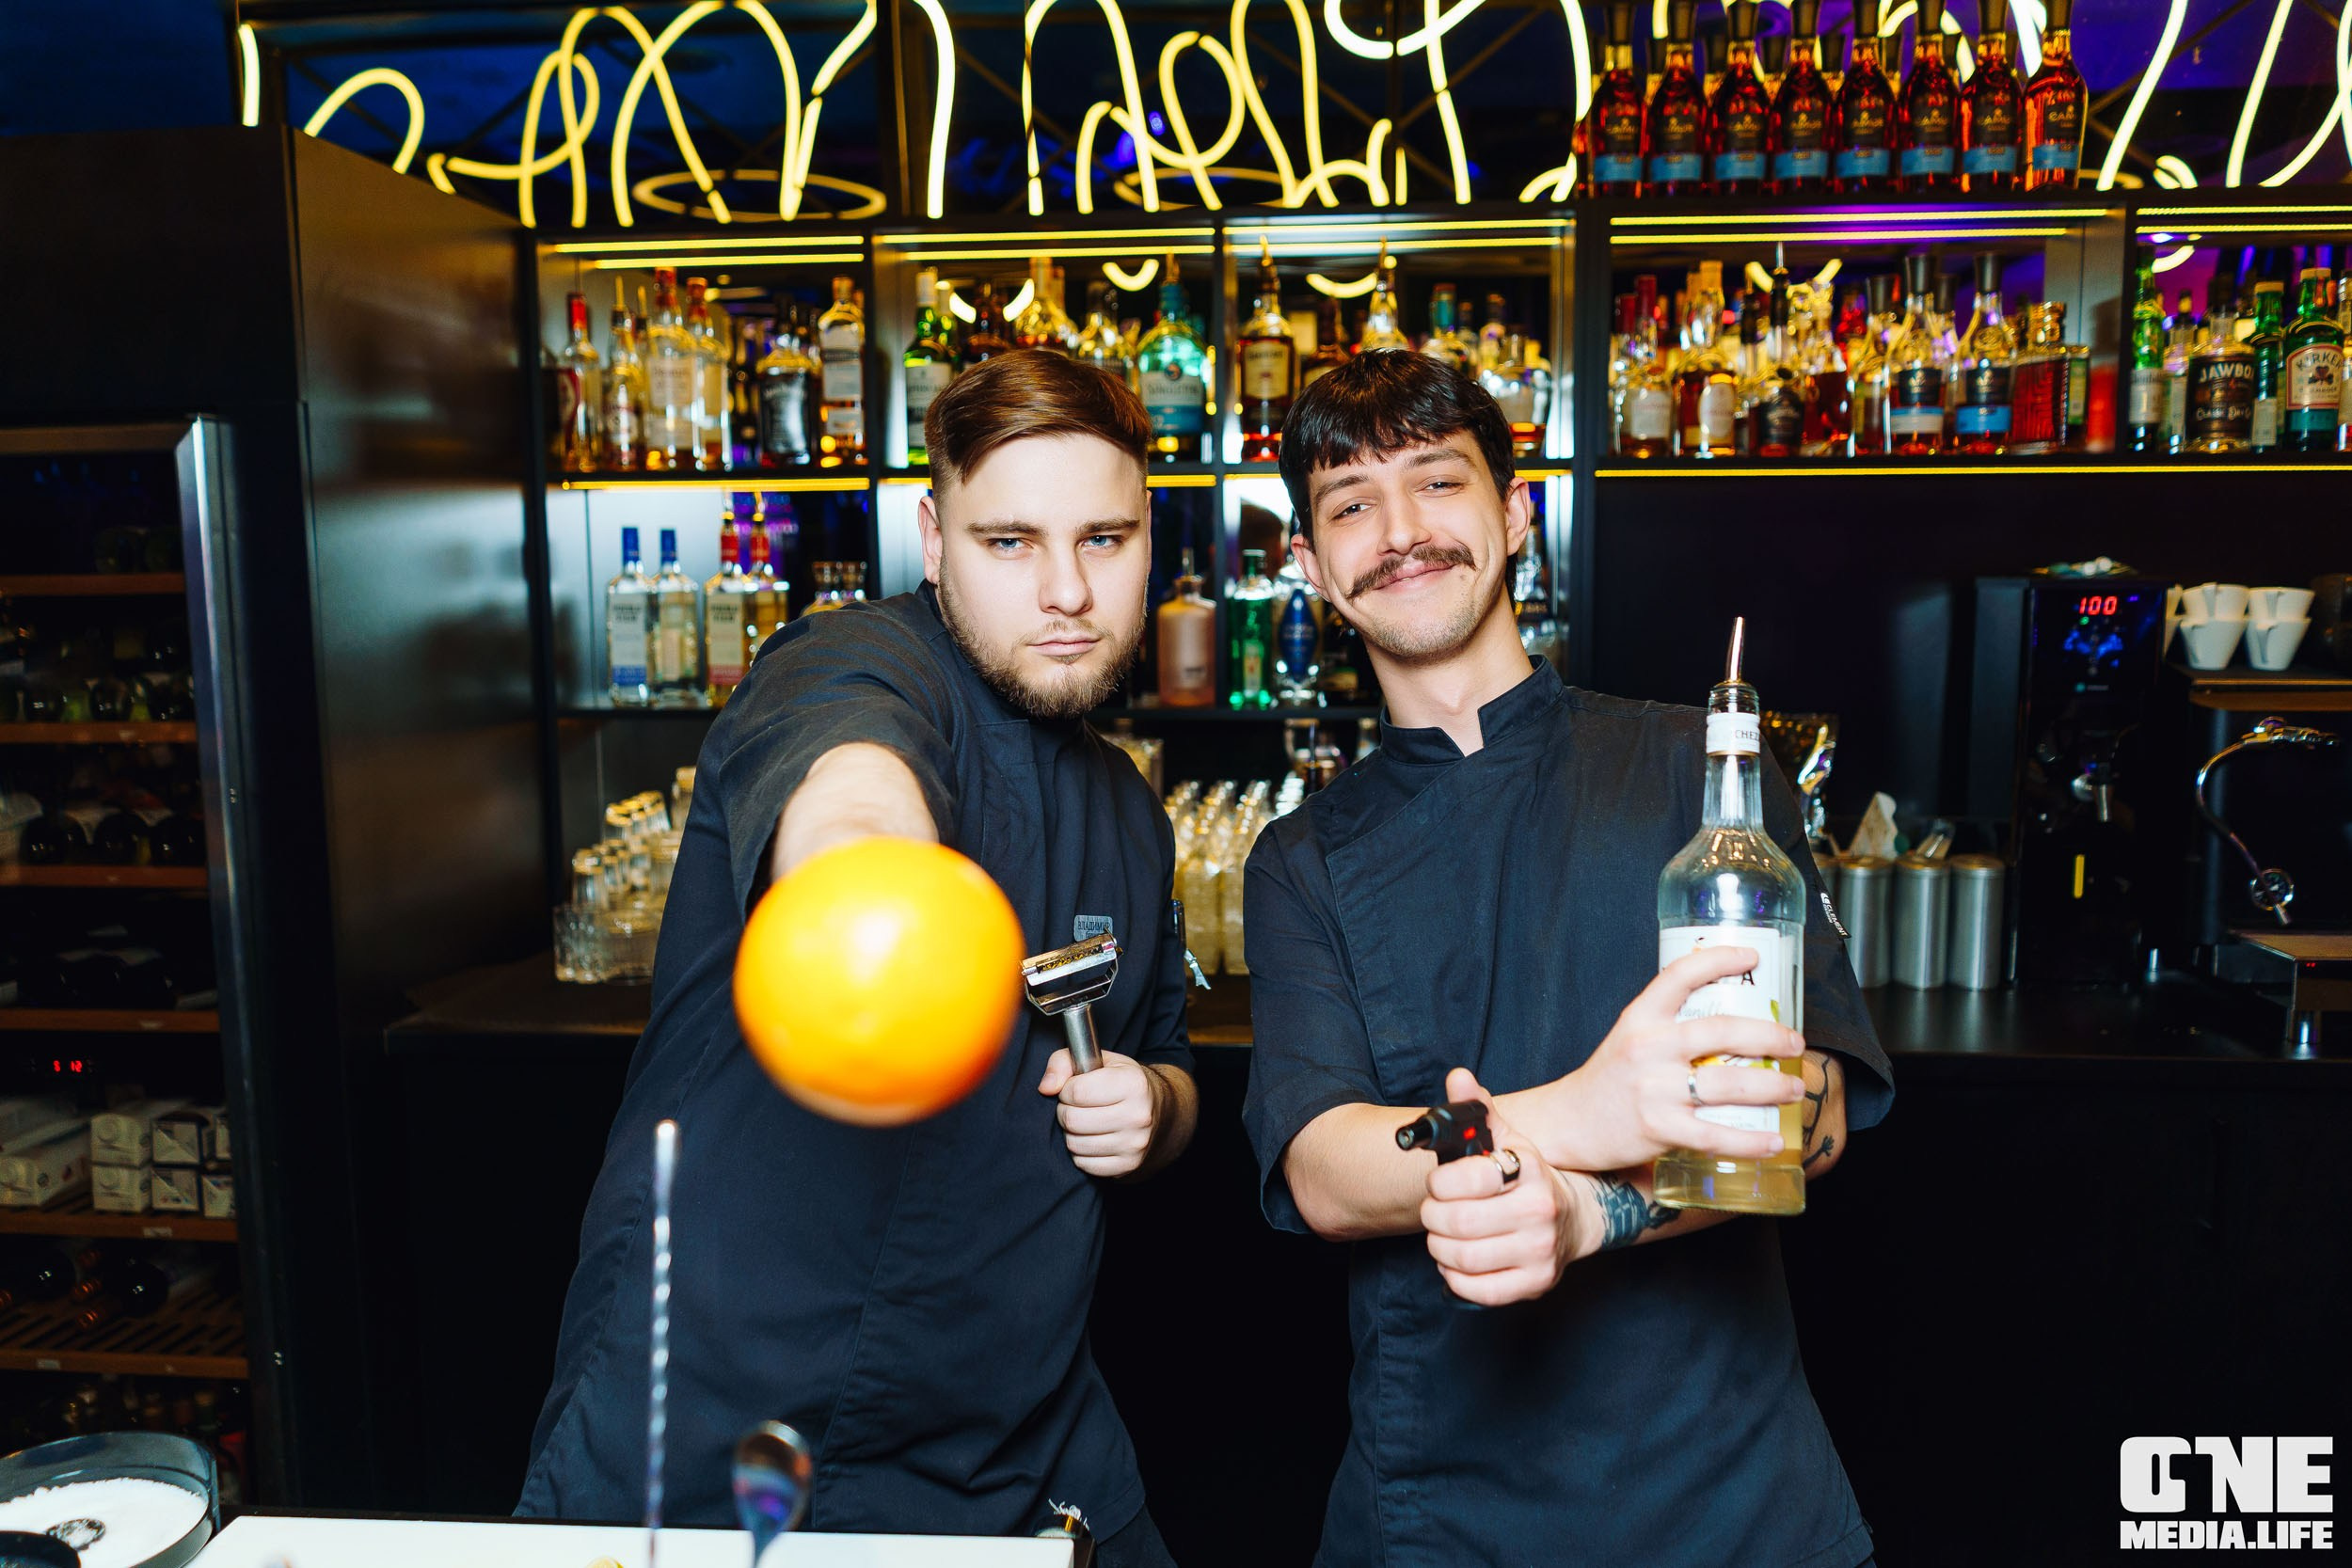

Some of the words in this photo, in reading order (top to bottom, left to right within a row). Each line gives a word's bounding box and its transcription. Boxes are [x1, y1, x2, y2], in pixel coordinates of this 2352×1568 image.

[2199, 361, 2254, 384] JAWBO
[2079, 595, 2118, 615] 100
[1826, 904, 1849, 936] CLEMENT
